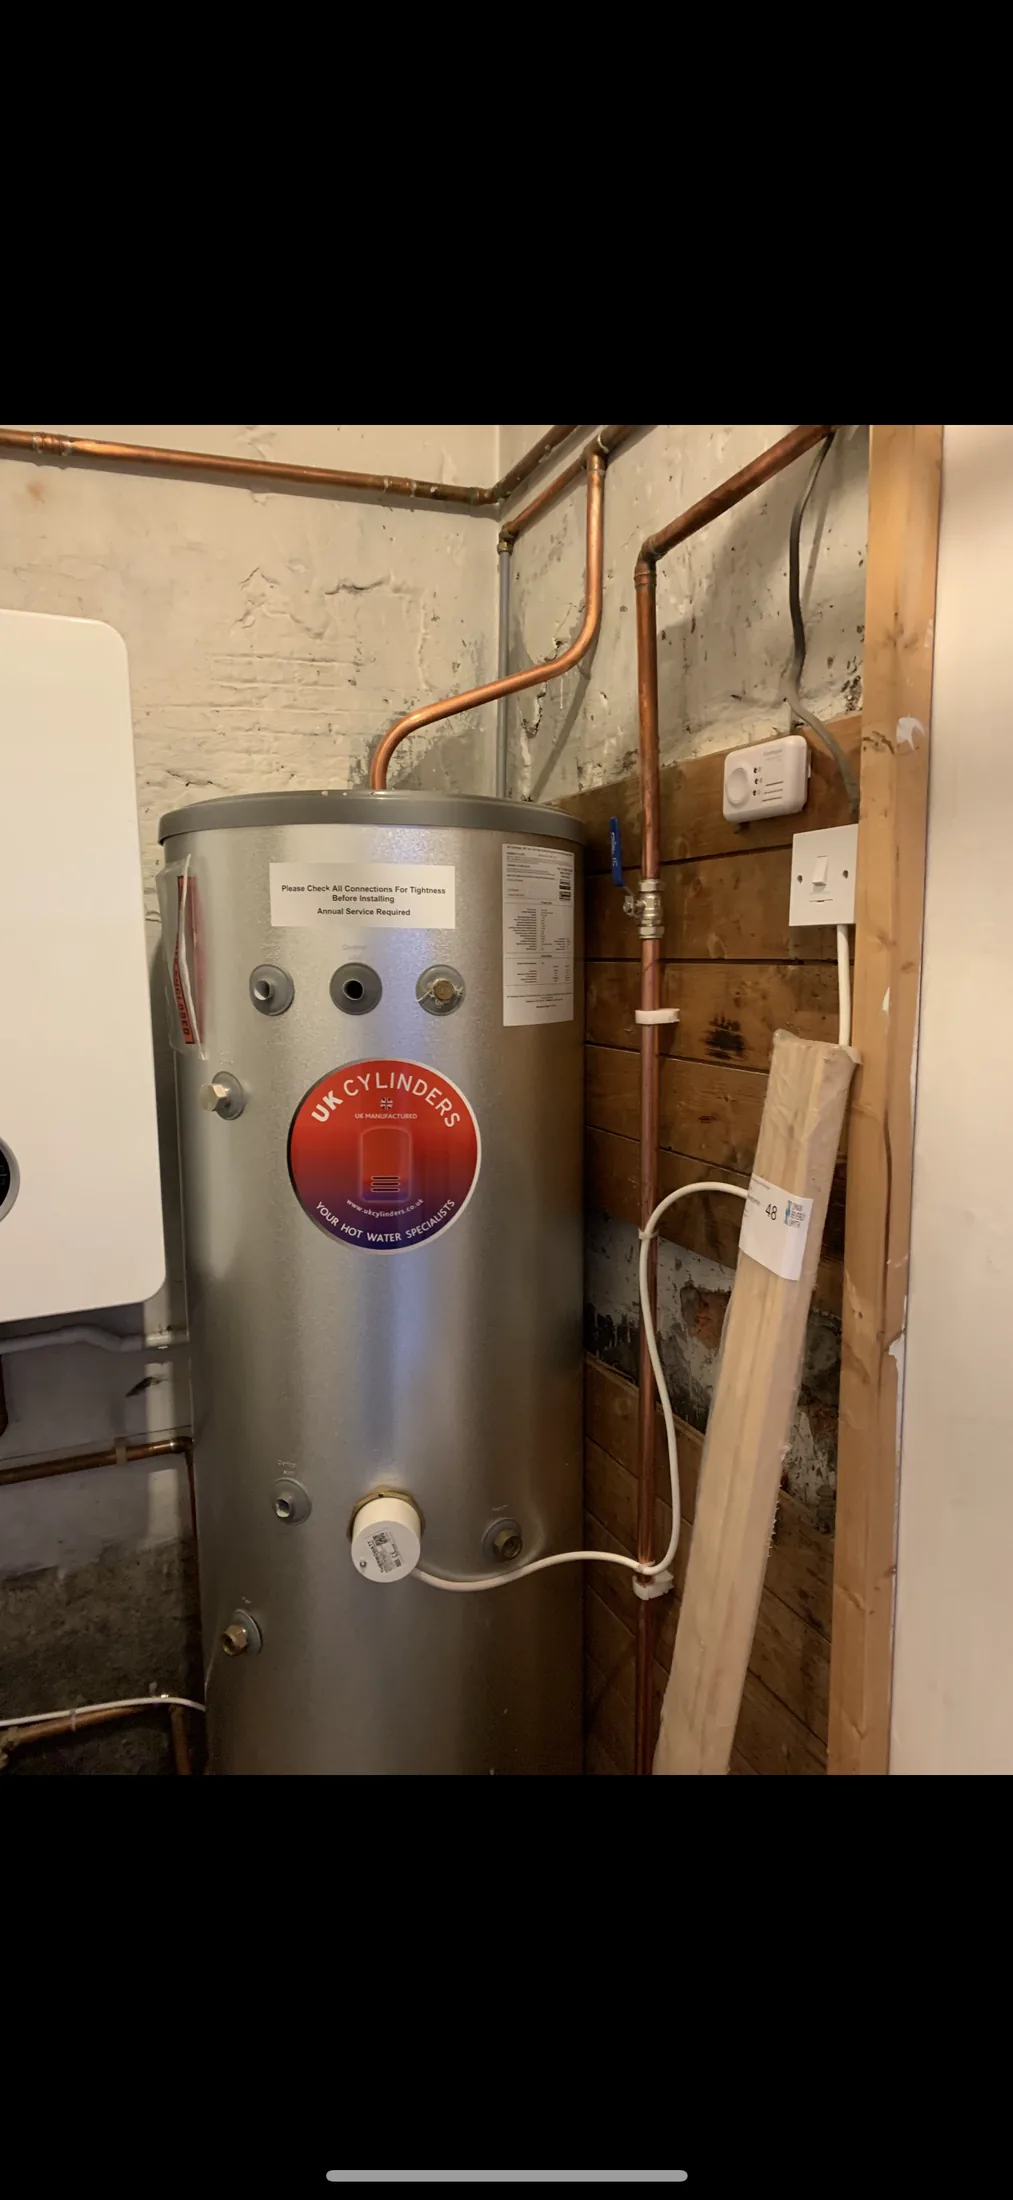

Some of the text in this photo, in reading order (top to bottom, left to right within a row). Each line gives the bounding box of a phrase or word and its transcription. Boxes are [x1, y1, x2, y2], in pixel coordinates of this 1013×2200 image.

[332, 894, 395, 904] Before Installing
[344, 885, 393, 893] Connections
[410, 886, 446, 895] Tightness
[345, 908, 374, 916] Service
[376, 908, 411, 917] Required
[311, 1072, 461, 1128] UK CYLINDERS
[346, 1199, 425, 1219] www.ukcylinders.co.uk
[765, 1203, 778, 1221] 48
[316, 1199, 456, 1243] YOUR HOT WATER SPECIALISTS
